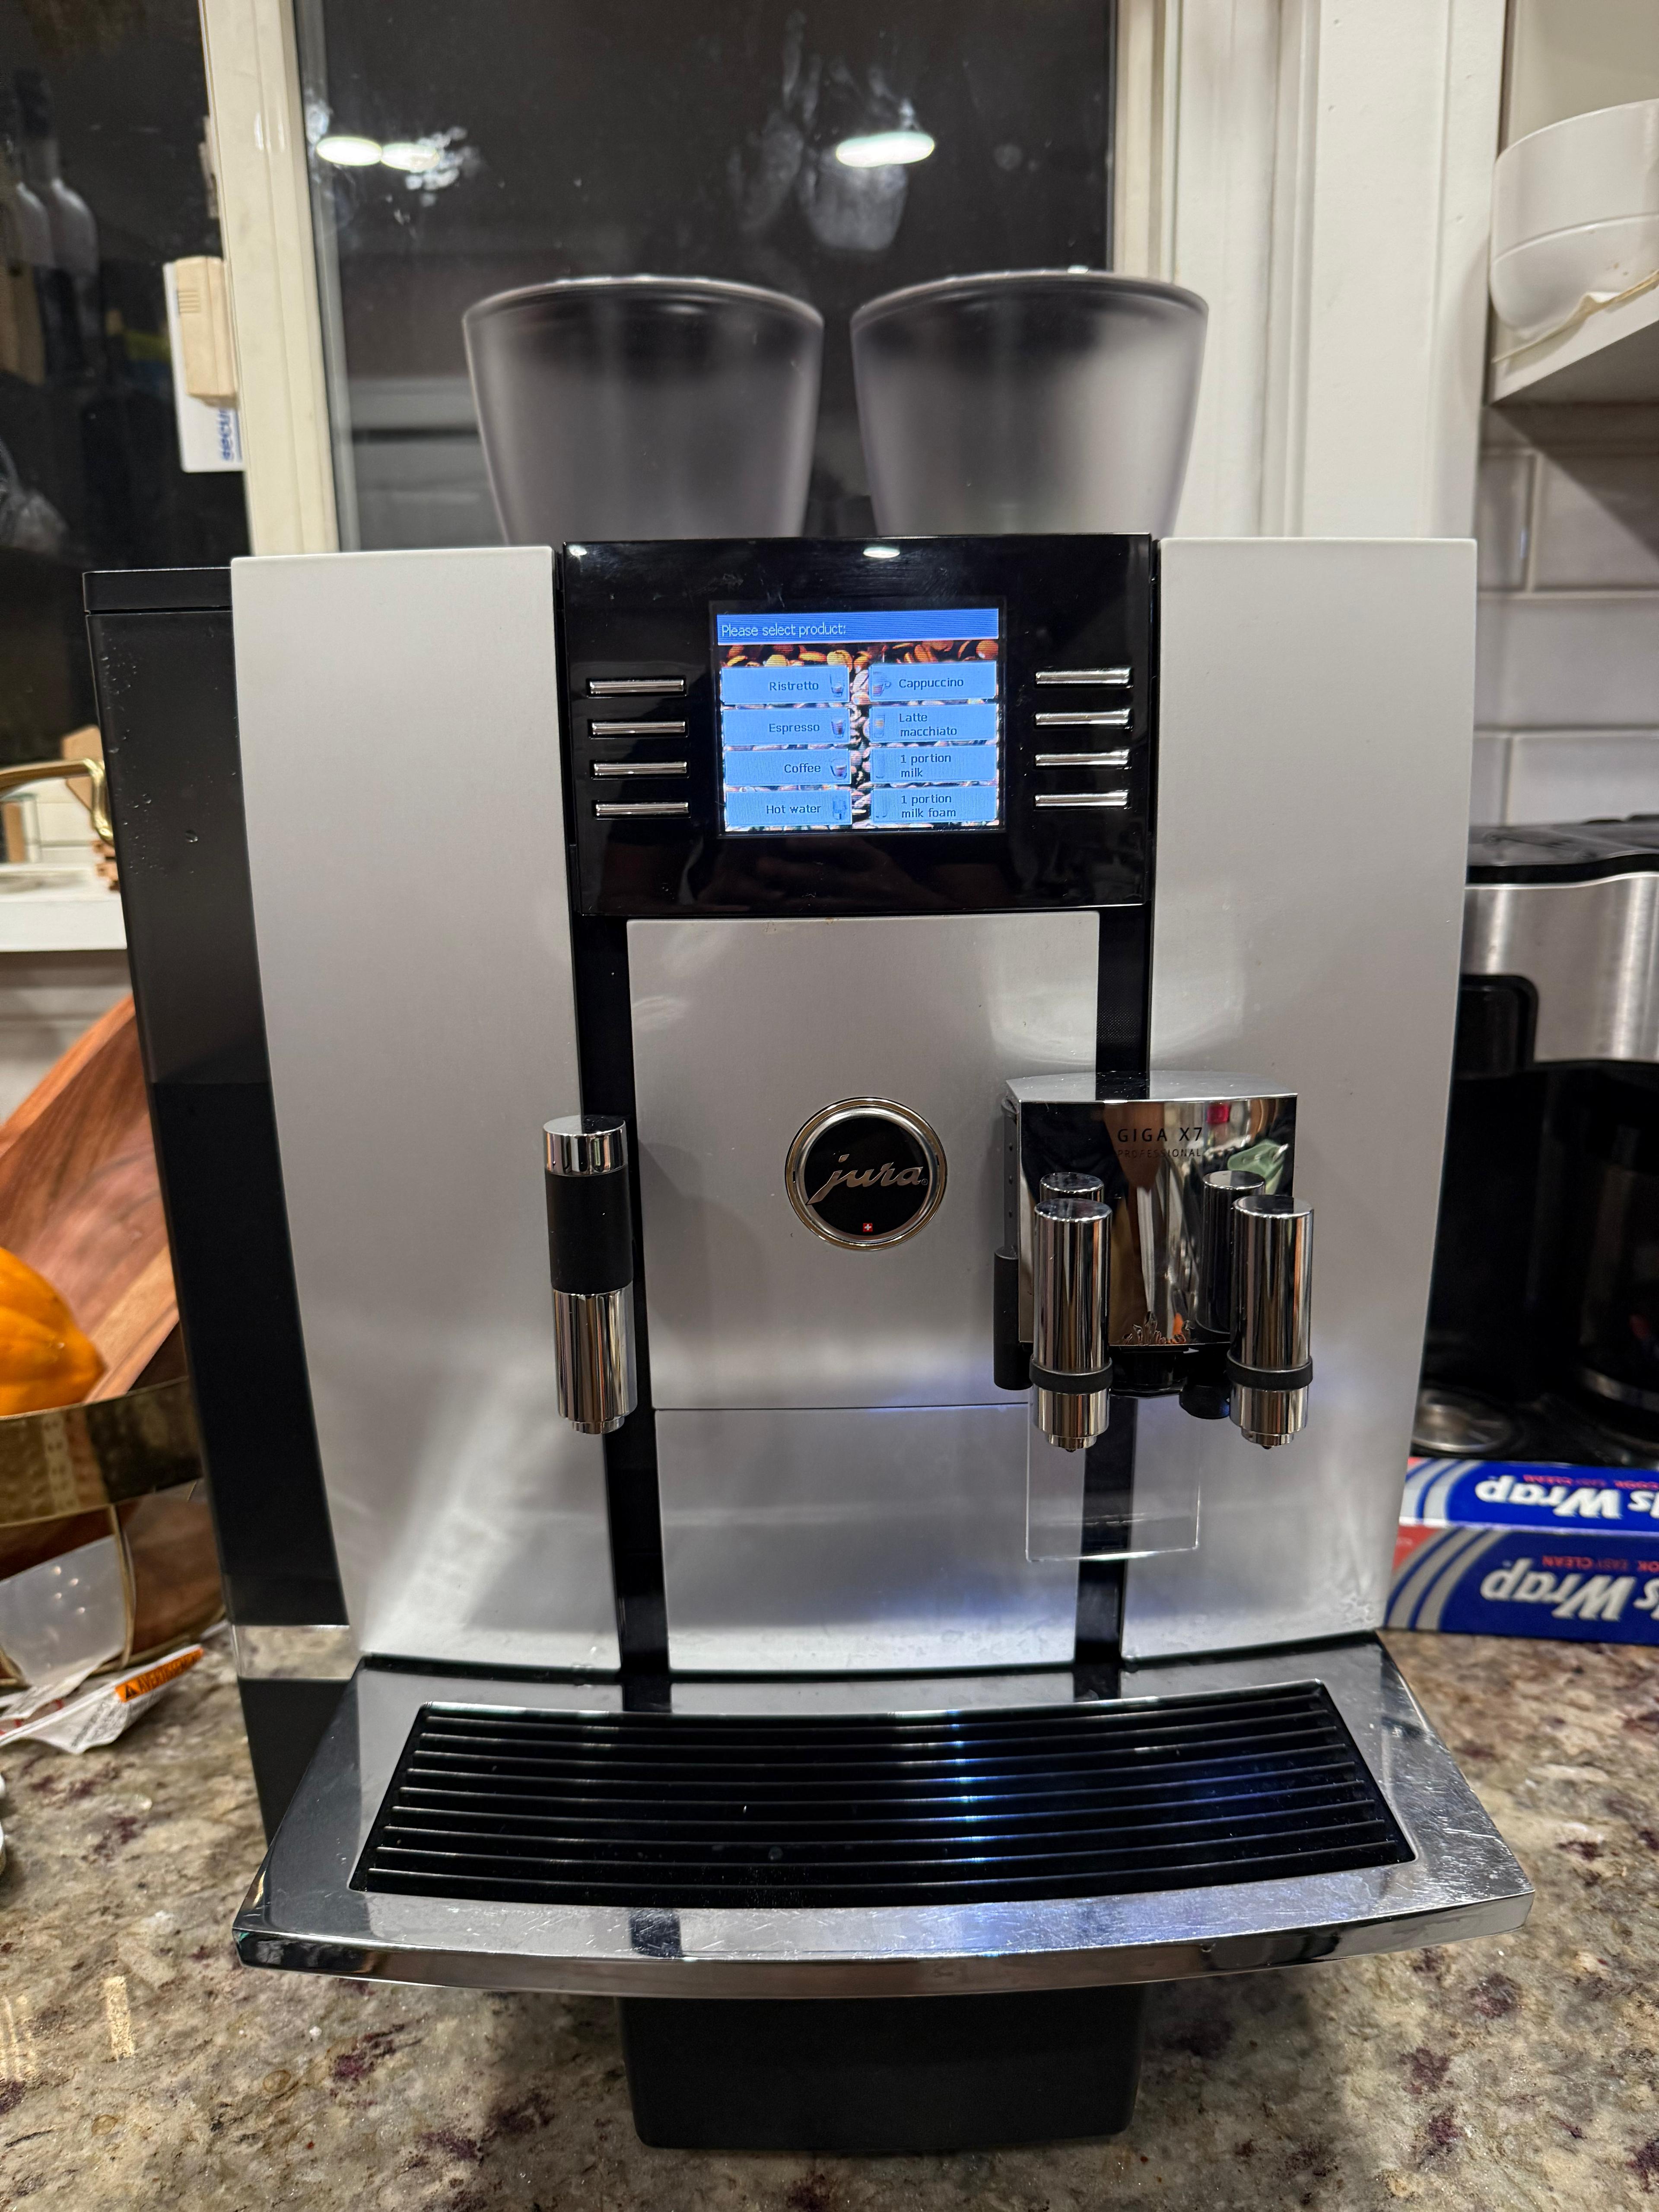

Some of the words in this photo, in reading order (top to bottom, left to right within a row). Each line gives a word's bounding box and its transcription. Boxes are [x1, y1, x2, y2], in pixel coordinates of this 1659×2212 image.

[721, 623, 759, 637] Please
[762, 622, 796, 636] select
[799, 622, 846, 638] product:
[769, 681, 819, 691] Ristretto
[899, 677, 964, 690] Cappuccino
[899, 713, 928, 722] Latte
[769, 723, 820, 735] Espresso
[900, 726, 957, 737] macchiato
[901, 754, 907, 763] 1
[911, 753, 951, 766] portion
[784, 763, 821, 773] Coffee
[901, 767, 923, 778] milk
[901, 795, 907, 804] 1
[911, 794, 952, 806] portion
[766, 805, 785, 814] Hot
[789, 804, 822, 814] water
[901, 808, 924, 818] milk
[928, 807, 957, 817] foam
[1117, 1128, 1167, 1143] GIGA
[1179, 1127, 1202, 1141] X7
[1118, 1148, 1201, 1159] PROFESSIONAL
[805, 1154, 924, 1206] jura
[1474, 1475, 1623, 1519] Wrap
[1541, 1555, 1593, 1570] CLEAN
[1480, 1558, 1637, 1621] Wrap
